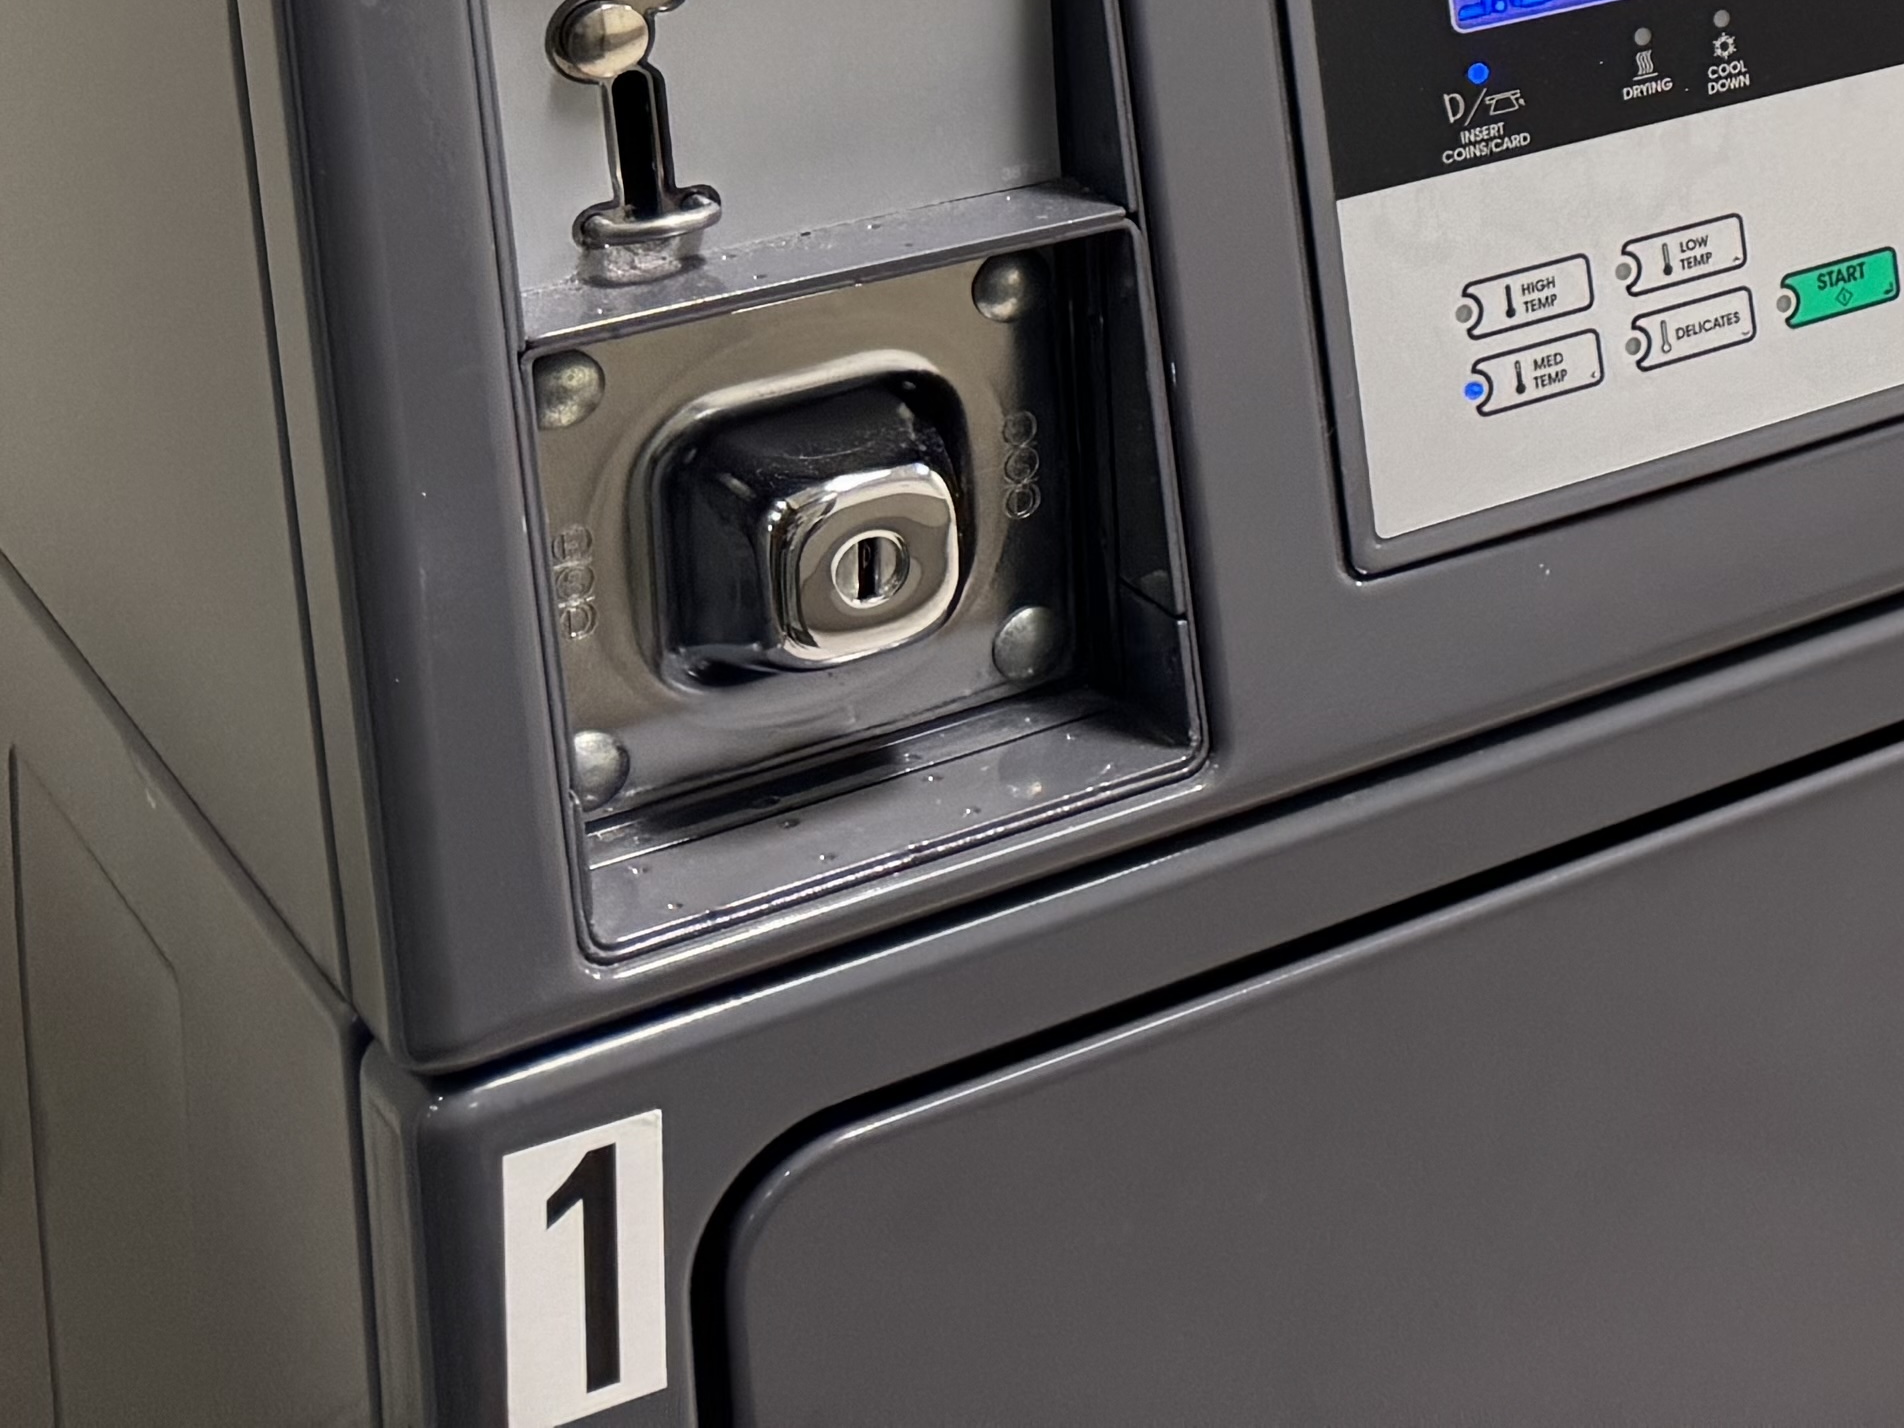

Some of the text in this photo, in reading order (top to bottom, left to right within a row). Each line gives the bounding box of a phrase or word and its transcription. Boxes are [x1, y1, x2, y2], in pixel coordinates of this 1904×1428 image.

[1707, 59, 1748, 80] COOL
[1622, 76, 1674, 101] DRYING
[1707, 73, 1750, 96] DOWN
[1459, 121, 1505, 145] INSERT
[1441, 131, 1531, 165] COINS/CARD
[1679, 234, 1710, 255] LOW
[1679, 251, 1713, 272] TEMP
[1520, 275, 1556, 297] HIGH
[1816, 261, 1867, 291] START
[1522, 293, 1559, 315] TEMP
[1674, 310, 1741, 341] DELICATES
[1532, 351, 1564, 373] MED
[1532, 369, 1569, 391] TEMP
[546, 1142, 621, 1394] 1
